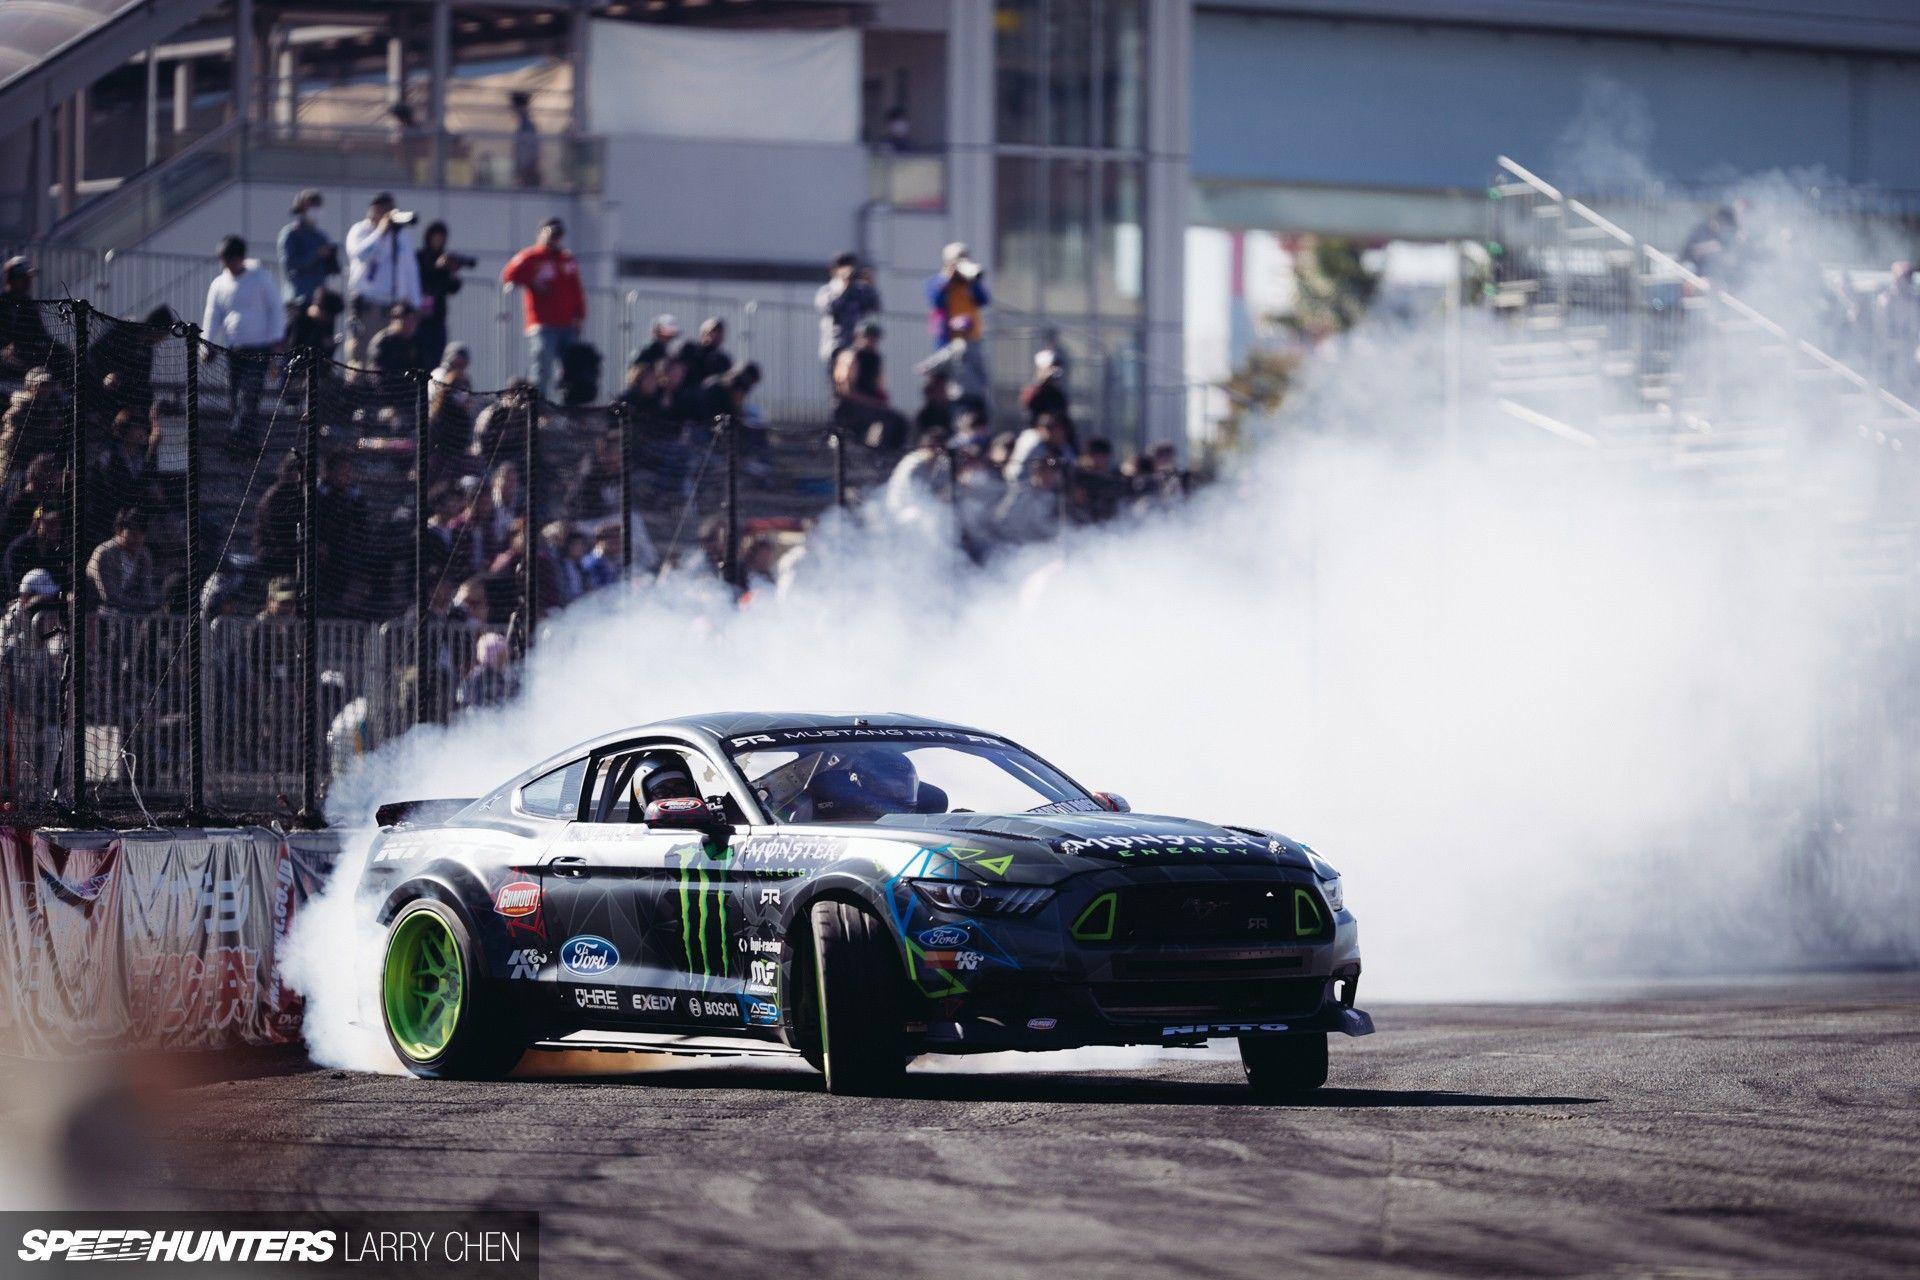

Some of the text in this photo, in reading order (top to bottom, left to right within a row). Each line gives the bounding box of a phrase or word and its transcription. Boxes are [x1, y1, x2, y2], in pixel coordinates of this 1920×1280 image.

[784, 728, 957, 739] MUSTANG RTR
[738, 836, 839, 863] MONSTER
[1061, 833, 1266, 850] MONSTER
[1118, 846, 1249, 857] ENERGY
[754, 867, 817, 880] ENERGY
[499, 888, 538, 908] GUMOUT
[929, 929, 960, 945] Ford
[571, 941, 609, 970] Ford
[584, 988, 619, 1006] HRE
[632, 994, 677, 1012] EXEDY
[704, 1001, 739, 1017] BOSCH
[1162, 1023, 1289, 1036] NITTO
